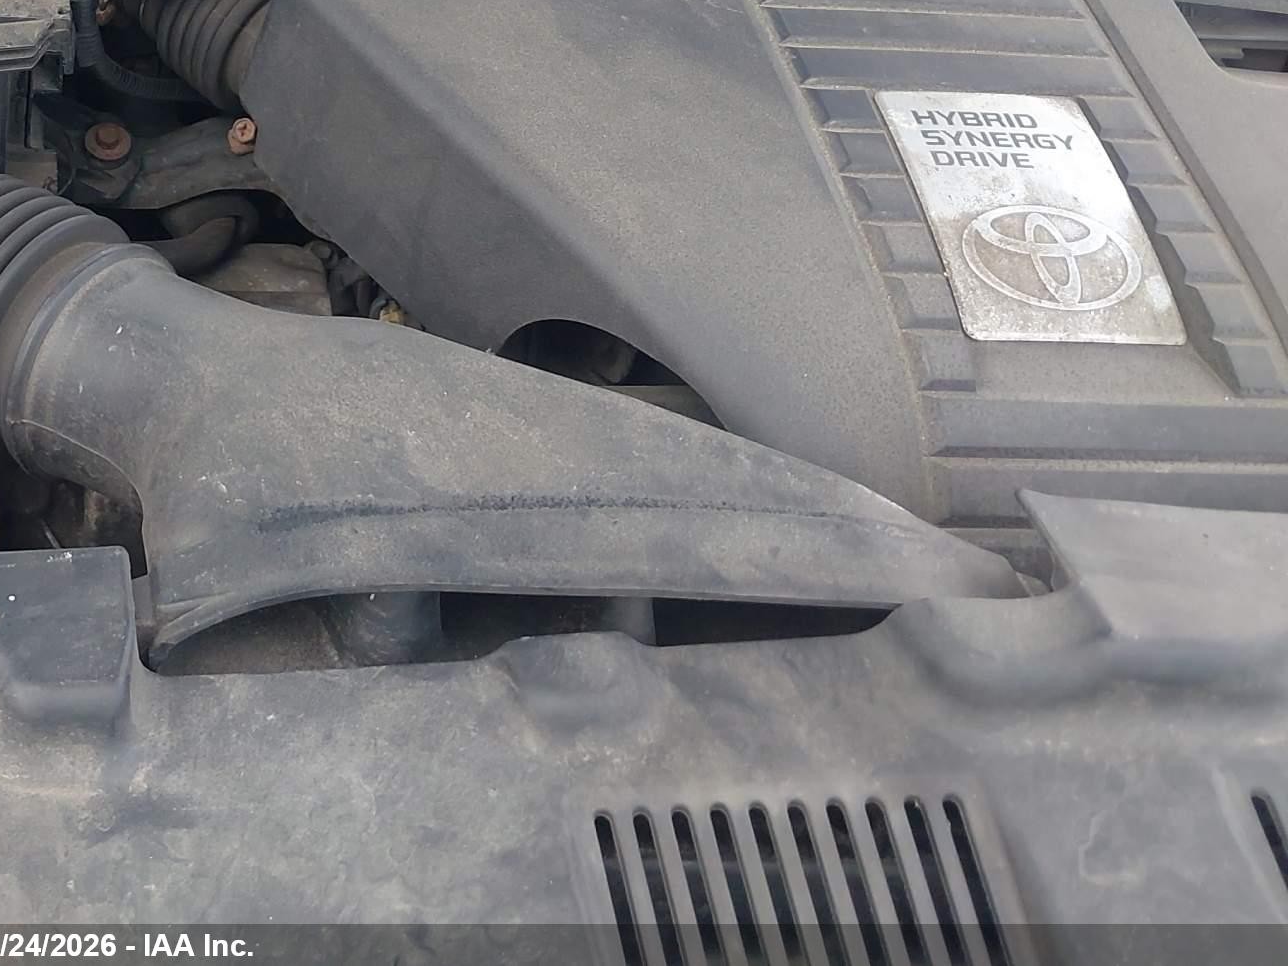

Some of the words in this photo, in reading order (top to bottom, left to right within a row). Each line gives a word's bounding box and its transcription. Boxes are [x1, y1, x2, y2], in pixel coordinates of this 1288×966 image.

[910, 109, 1038, 129] HYBRID
[922, 129, 1074, 151] SYNERGY
[929, 150, 1035, 170] DRIVE
